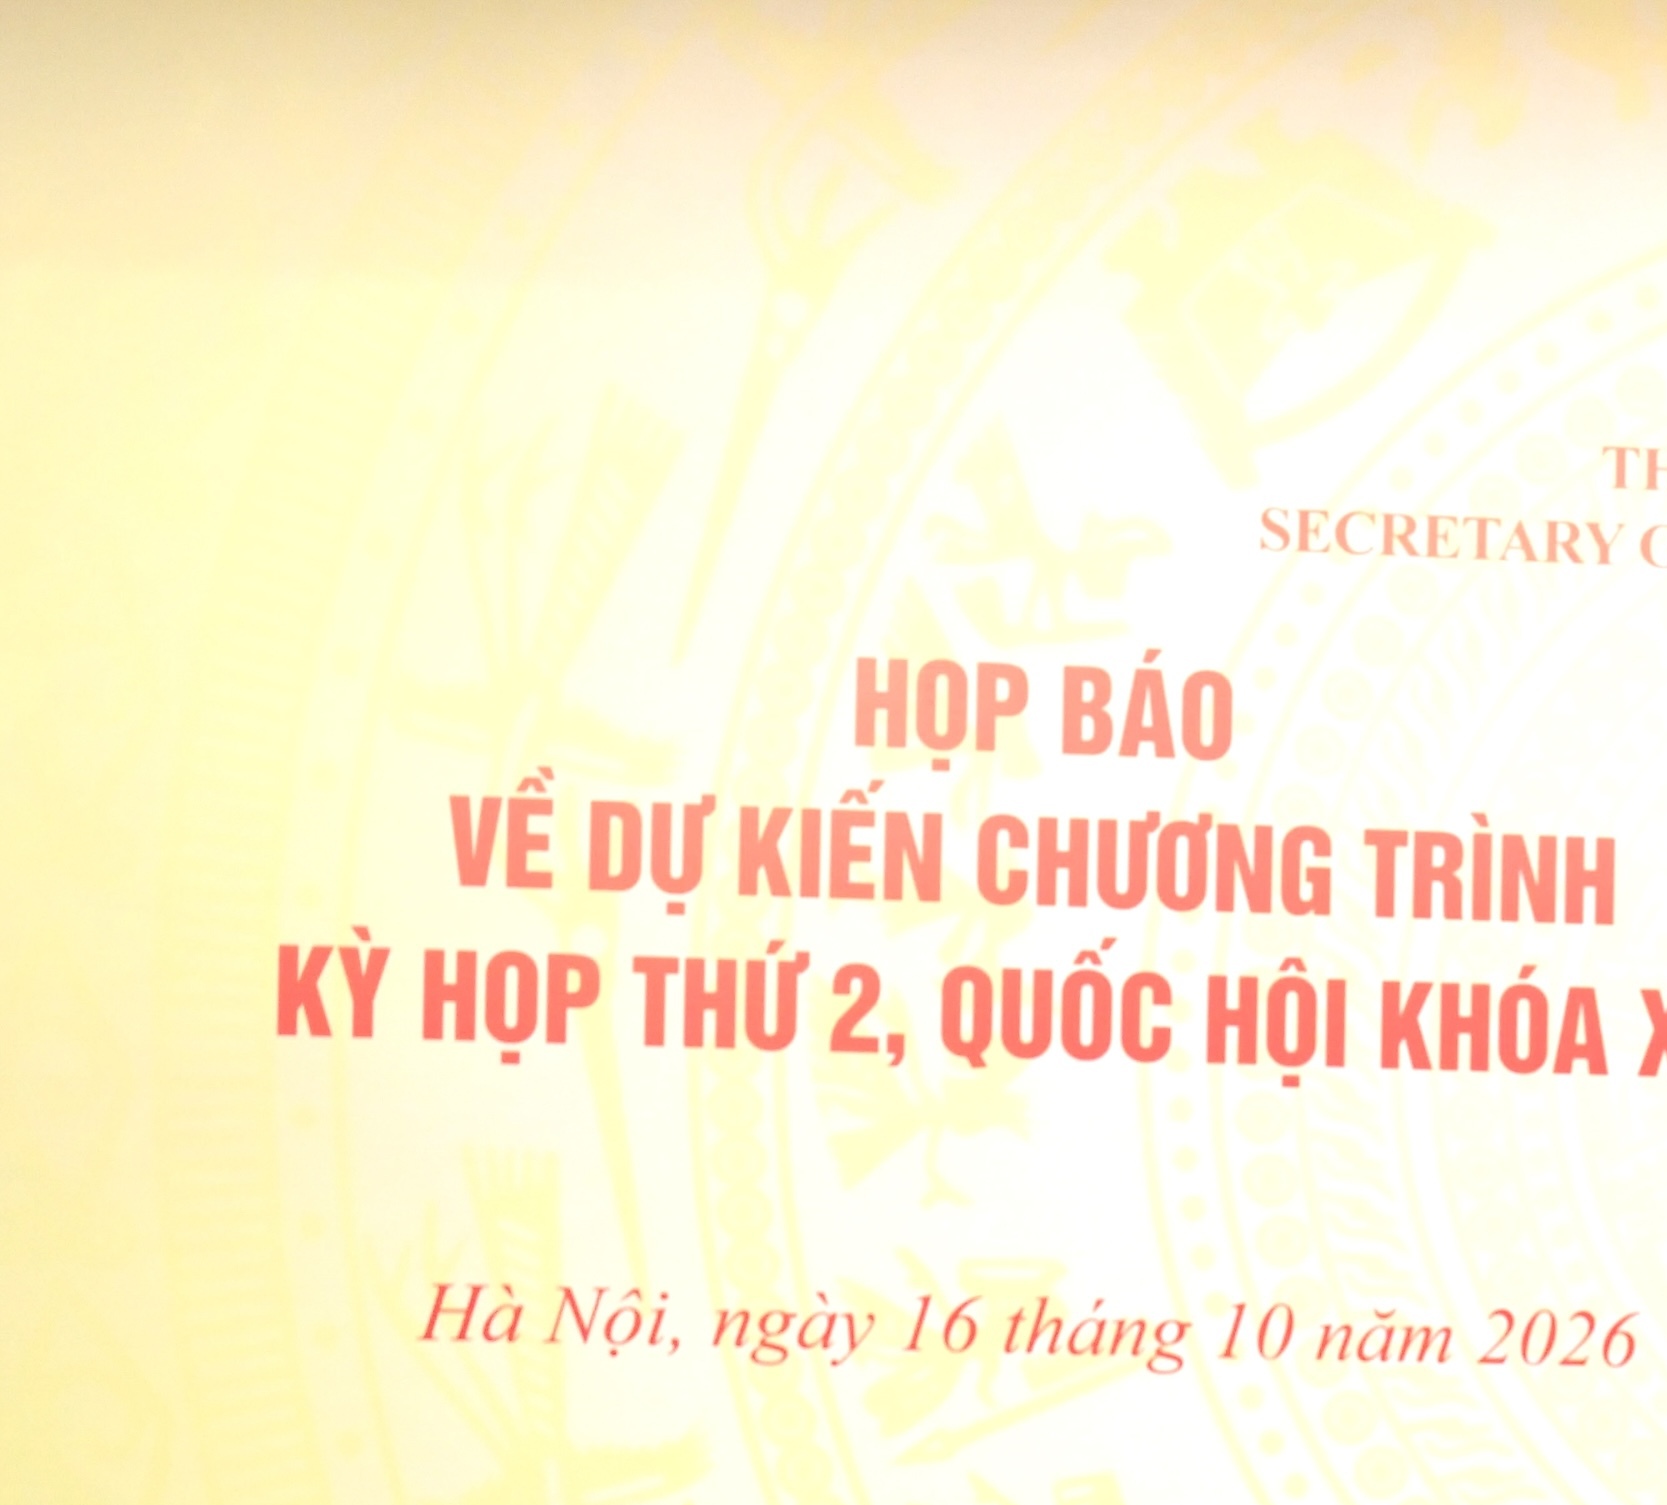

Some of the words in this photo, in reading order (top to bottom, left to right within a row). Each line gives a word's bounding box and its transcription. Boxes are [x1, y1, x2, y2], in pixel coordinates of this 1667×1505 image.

[1262, 509, 1625, 566] SECRETARY
[855, 657, 1028, 771] HỌP
[1062, 649, 1232, 761] BÁO
[450, 767, 554, 889] VỀ
[589, 795, 716, 915] DỰ
[738, 780, 942, 902] KIẾN
[978, 811, 1331, 916] CHƯƠNG
[1364, 813, 1615, 925] TRÌNH
[277, 926, 390, 1038] KỲ
[422, 949, 600, 1065] HỌP
[633, 940, 810, 1051] THỨ
[830, 963, 905, 1066] 2,
[941, 938, 1172, 1068] QUỐC
[1207, 957, 1346, 1088] HỘI
[1381, 965, 1608, 1075] KHÓA
[421, 1284, 523, 1342] Hà
[546, 1287, 679, 1357] Nội,
[713, 1292, 875, 1367] ngày
[906, 1296, 977, 1352] 16
[1004, 1296, 1191, 1373] tháng
[1222, 1303, 1294, 1358] 10
[1317, 1312, 1452, 1363] năm
[1478, 1309, 1635, 1366] 2026
